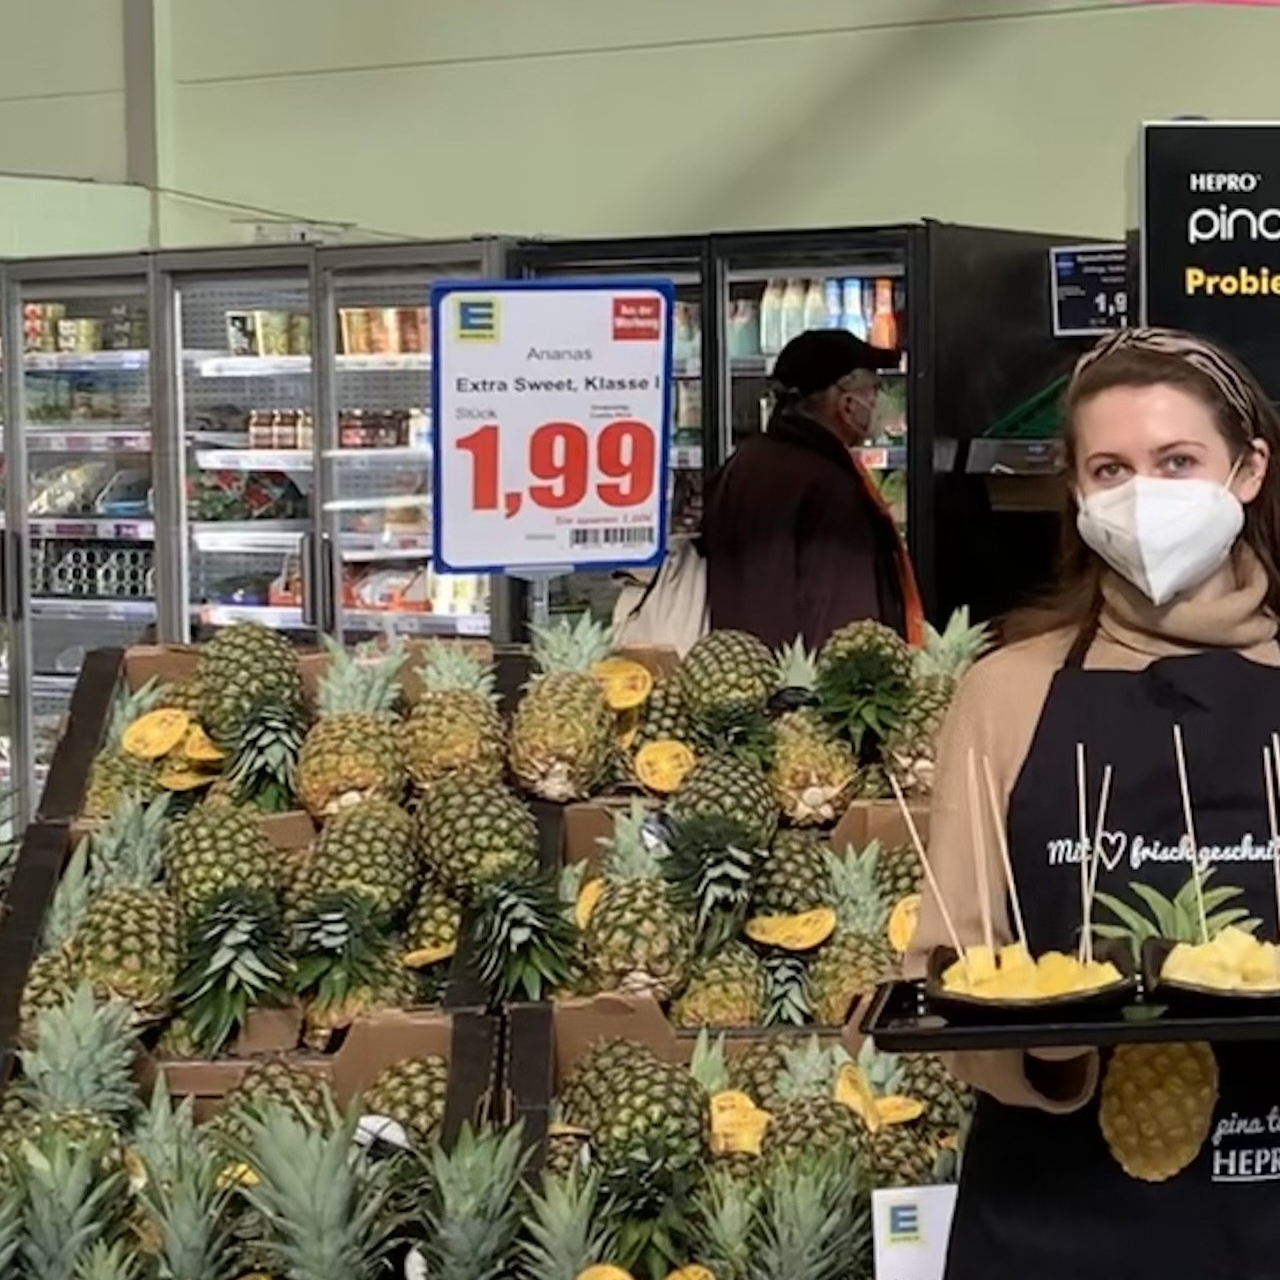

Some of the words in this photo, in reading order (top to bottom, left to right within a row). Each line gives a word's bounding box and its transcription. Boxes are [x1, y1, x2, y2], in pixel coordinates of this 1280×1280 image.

[1189, 173, 1257, 192] HEPRO
[526, 347, 593, 361] Ananas
[456, 376, 508, 393] Extra
[514, 375, 579, 393] Sweet,
[585, 374, 649, 391] Klasse
[455, 421, 656, 519] 1,99
